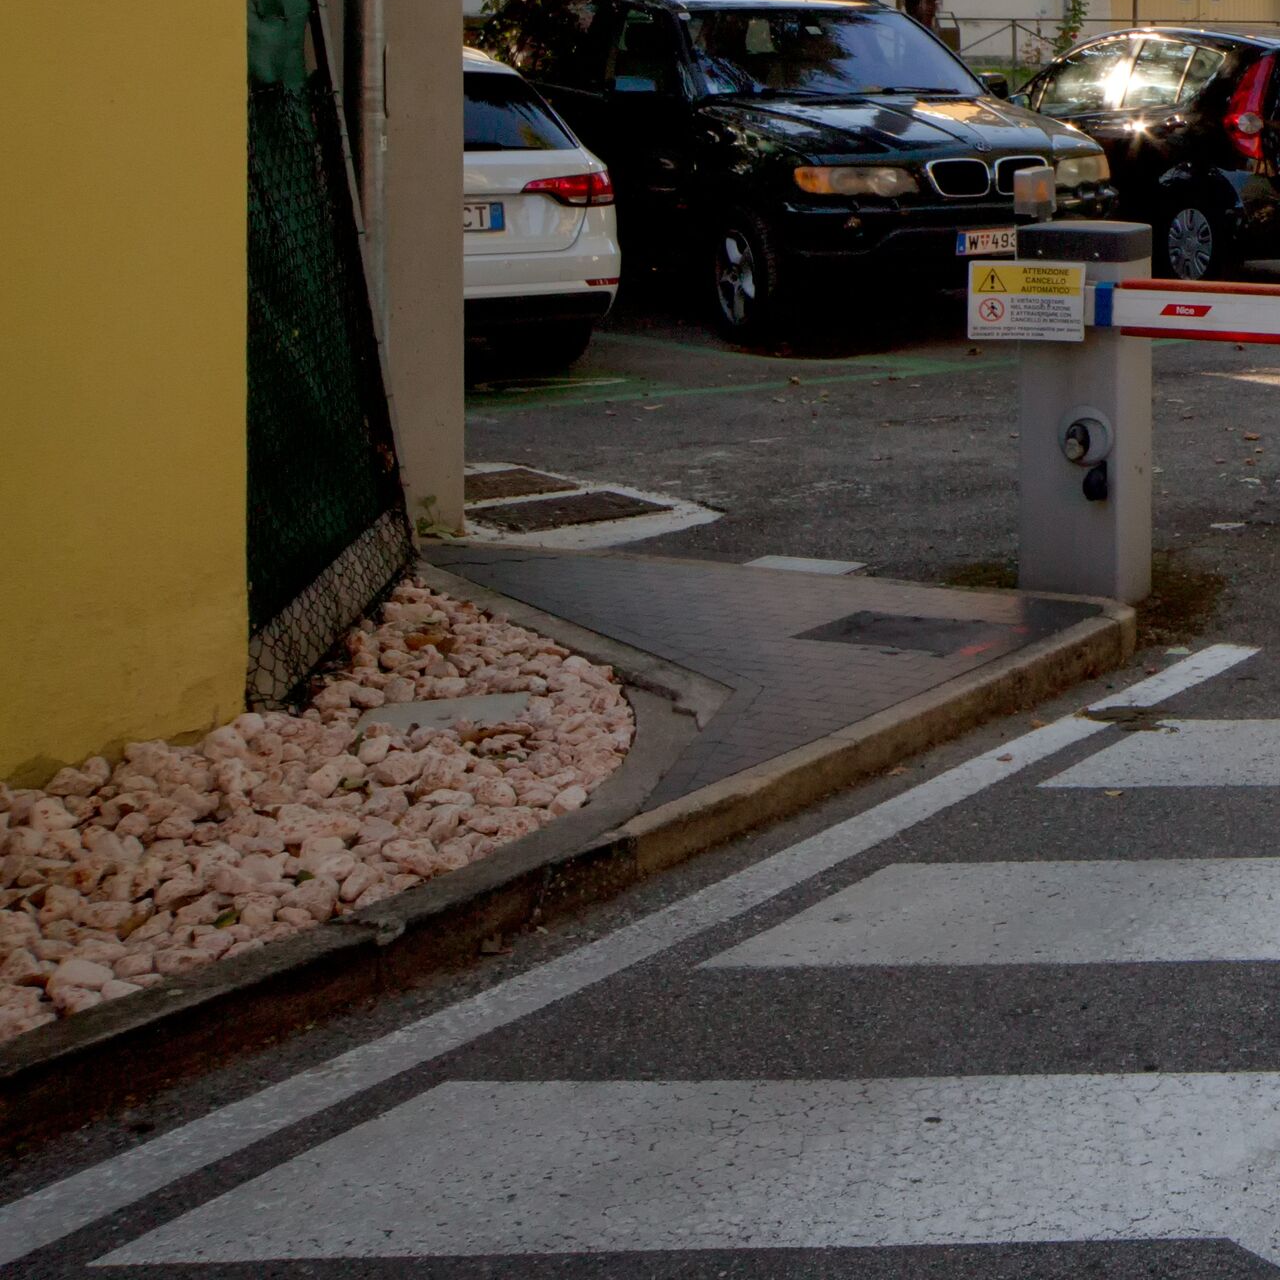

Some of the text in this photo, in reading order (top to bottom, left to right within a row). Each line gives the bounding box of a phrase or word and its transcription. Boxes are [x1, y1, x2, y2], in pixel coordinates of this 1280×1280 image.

[969, 235, 979, 250] W
[1022, 268, 1070, 276] ATTENZIONE
[1025, 277, 1066, 285] CANCELLO
[1021, 286, 1070, 294] AUTOMATICO
